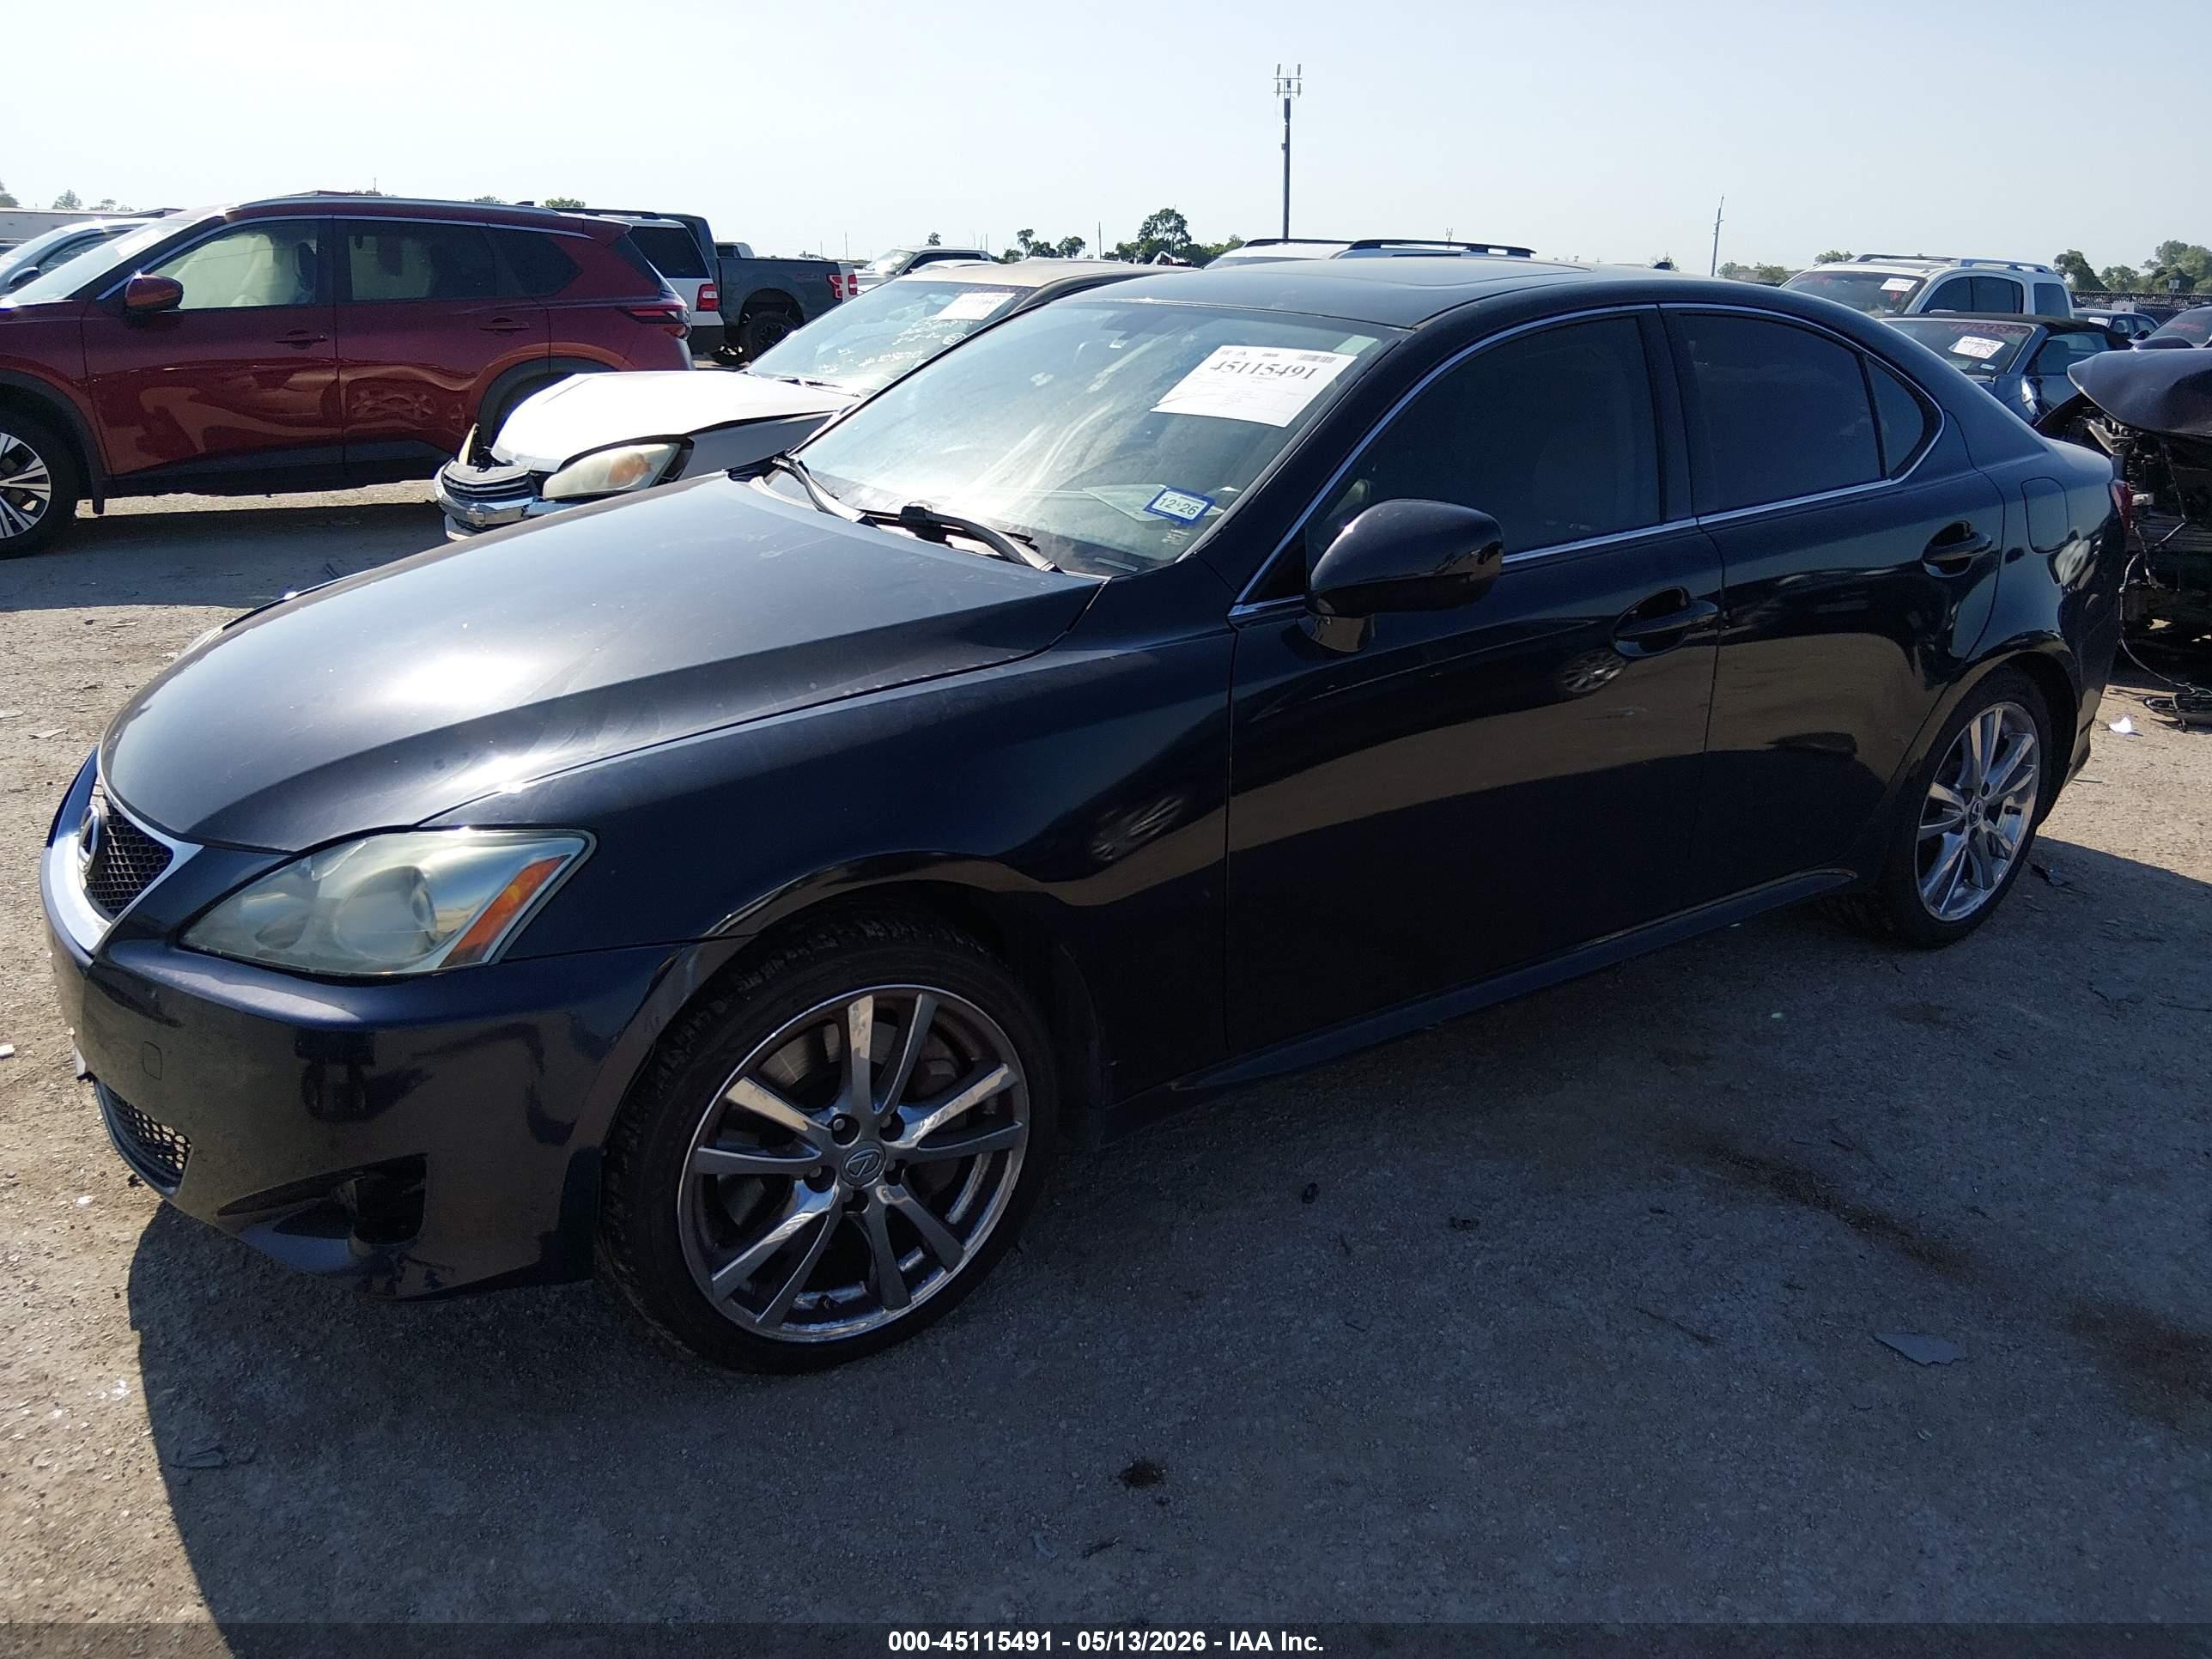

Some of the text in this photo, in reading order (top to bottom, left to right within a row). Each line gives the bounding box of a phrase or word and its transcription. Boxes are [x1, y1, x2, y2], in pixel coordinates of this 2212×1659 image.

[1209, 359, 1320, 380] 45115491
[1158, 497, 1200, 515] 12 26
